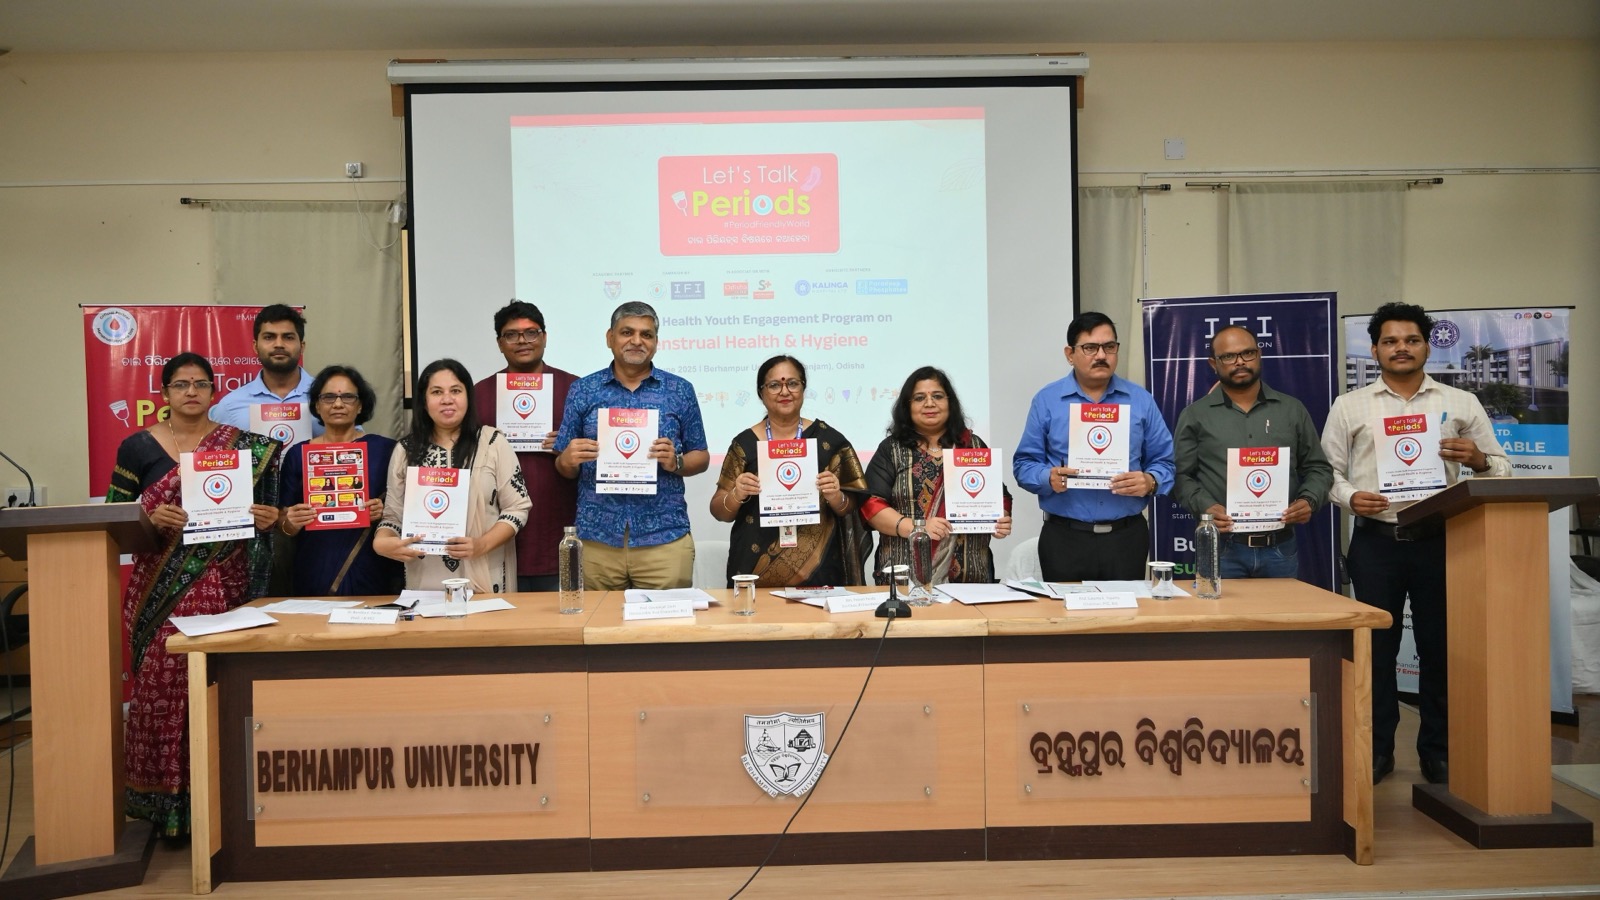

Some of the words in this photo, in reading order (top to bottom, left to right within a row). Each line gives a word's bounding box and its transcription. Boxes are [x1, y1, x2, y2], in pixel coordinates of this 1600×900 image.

[703, 166, 750, 184] Let's
[757, 165, 798, 183] Talk
[692, 188, 811, 217] Periods
[674, 283, 702, 294] IFI
[812, 281, 848, 289] KALINGA
[662, 315, 702, 327] Health
[705, 315, 740, 326] Youth
[743, 313, 819, 327] Engagement
[822, 312, 874, 325] Program
[877, 312, 893, 323] on
[656, 335, 720, 351] enstrual
[725, 333, 780, 349] Health
[784, 334, 797, 349] &
[801, 333, 868, 350] Hygiene
[678, 365, 697, 373] 2025
[703, 364, 749, 374] Berhampur
[804, 363, 833, 372] anjam),
[836, 362, 865, 370] Odisha
[1088, 411, 1114, 419] Periods
[1392, 423, 1421, 431] Periods
[1494, 428, 1513, 437] TD.
[1502, 440, 1546, 453] ABLE
[202, 459, 234, 467] Periods
[1246, 455, 1274, 463] Periods
[426, 475, 454, 483] Periods
[257, 747, 395, 793] BERHAMPUR
[403, 742, 540, 789] UNIVERSITY
[742, 756, 778, 797] BERHAMPUR
[796, 755, 829, 796] UNIVERSITY
